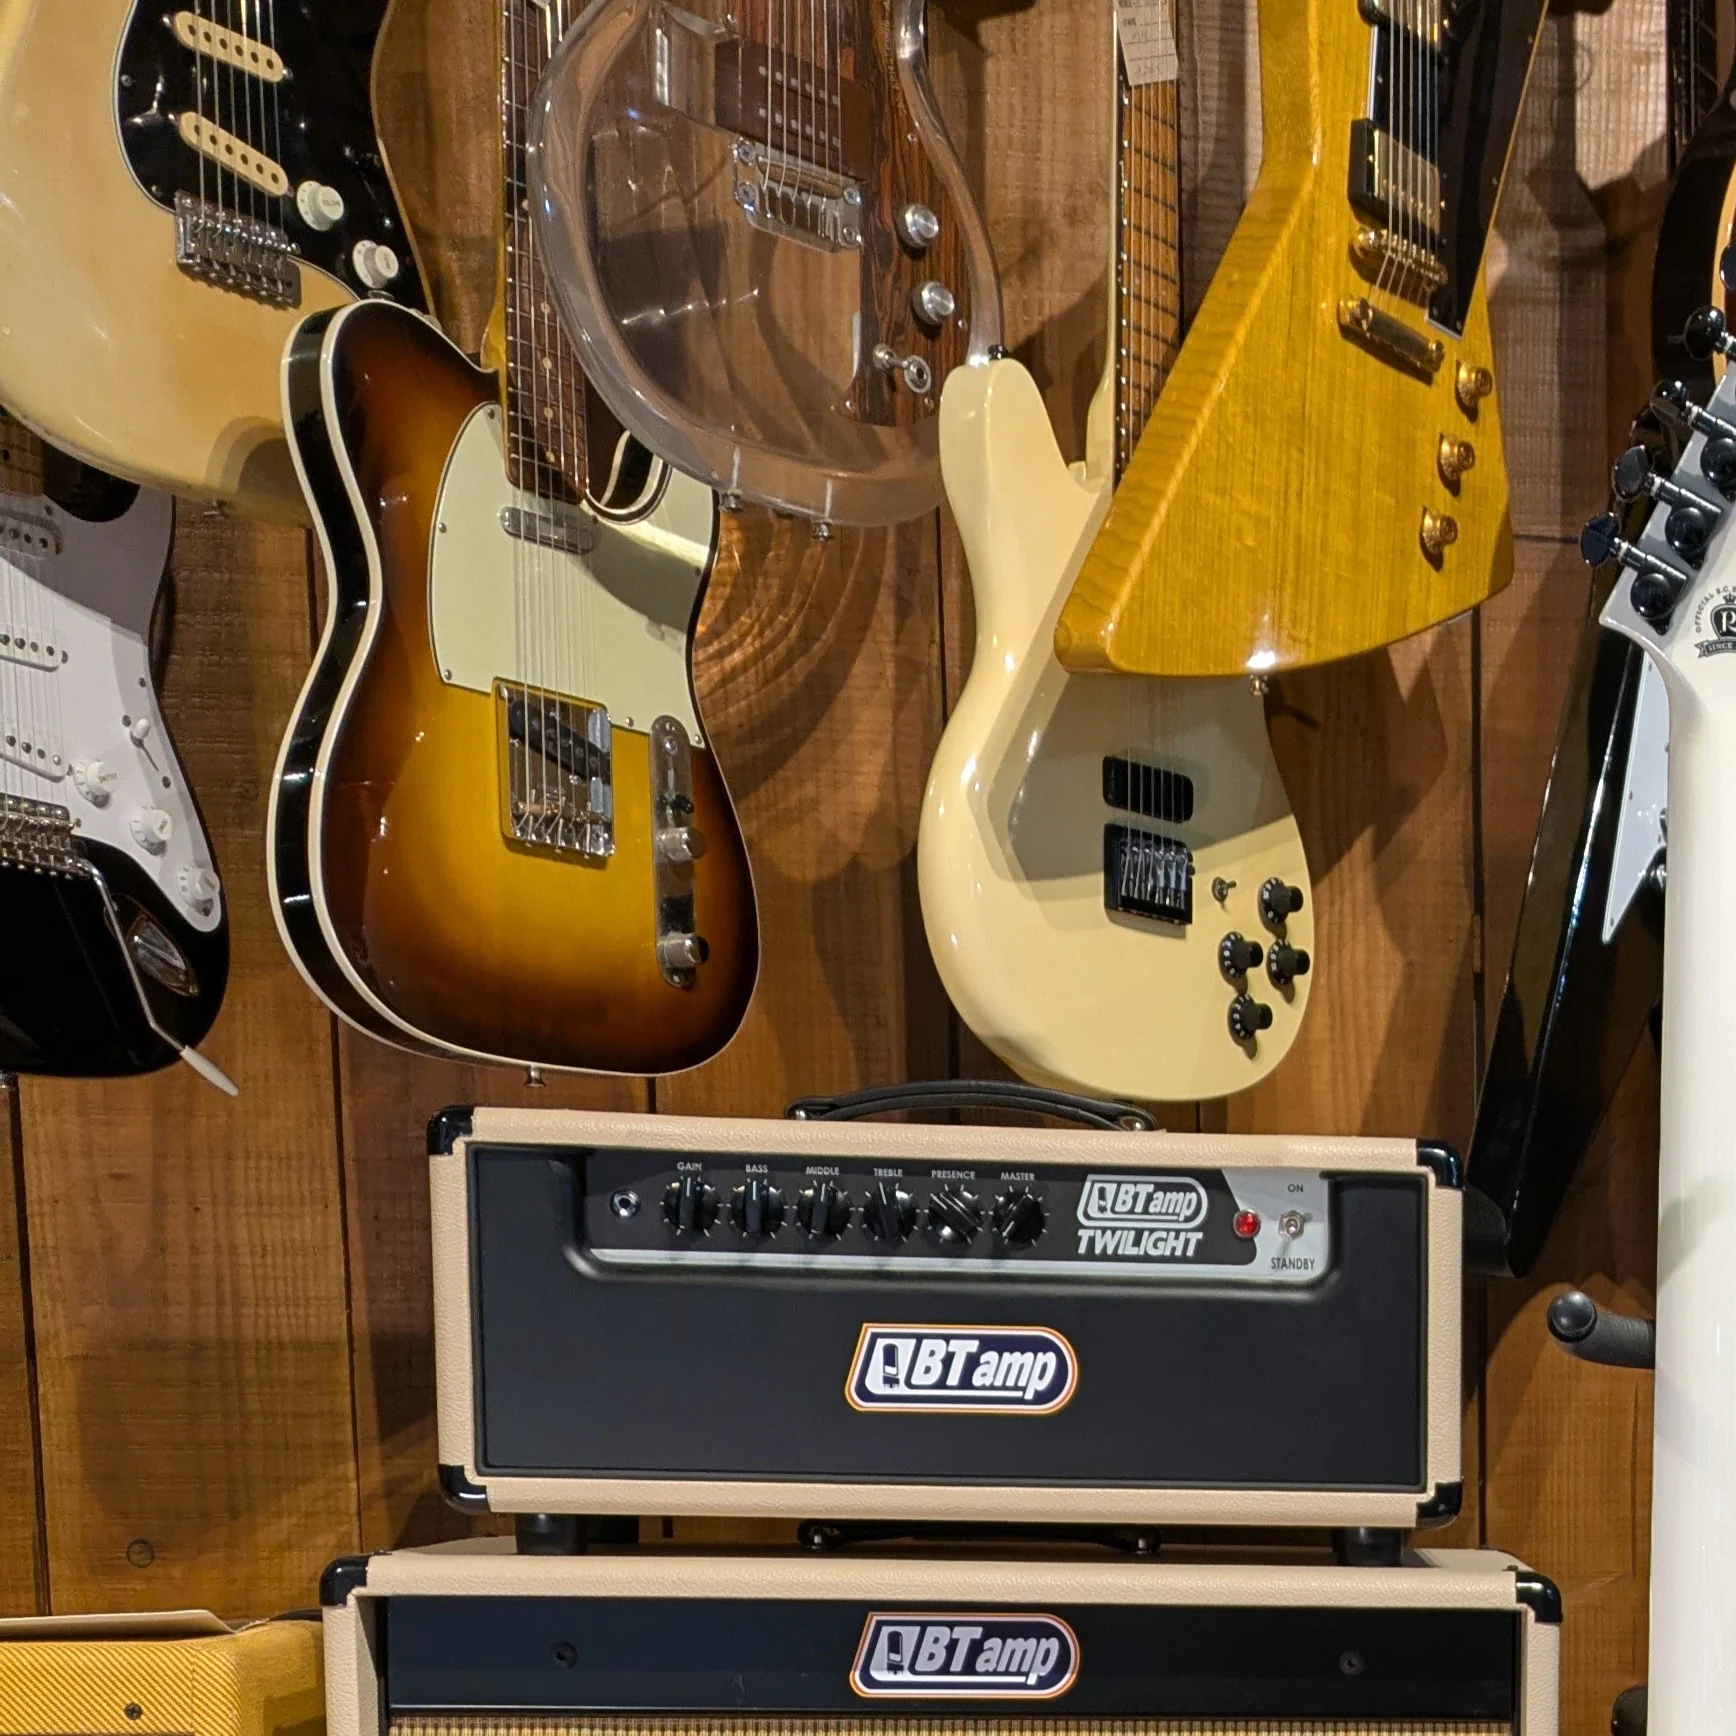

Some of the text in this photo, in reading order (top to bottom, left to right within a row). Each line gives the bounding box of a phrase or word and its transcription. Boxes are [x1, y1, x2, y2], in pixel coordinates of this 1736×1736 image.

[1694, 591, 1716, 634] OFFICIAL
[677, 1161, 703, 1172] GAIN
[745, 1163, 769, 1174] BASS
[805, 1165, 841, 1176] MIDDLE
[873, 1167, 904, 1178] TREBLE
[931, 1169, 977, 1180] PRESENCE
[1000, 1171, 1036, 1182] MASTER
[1287, 1183, 1305, 1194] ON
[1077, 1229, 1204, 1257] TWILIGHT
[1270, 1257, 1316, 1271] STANDBY
